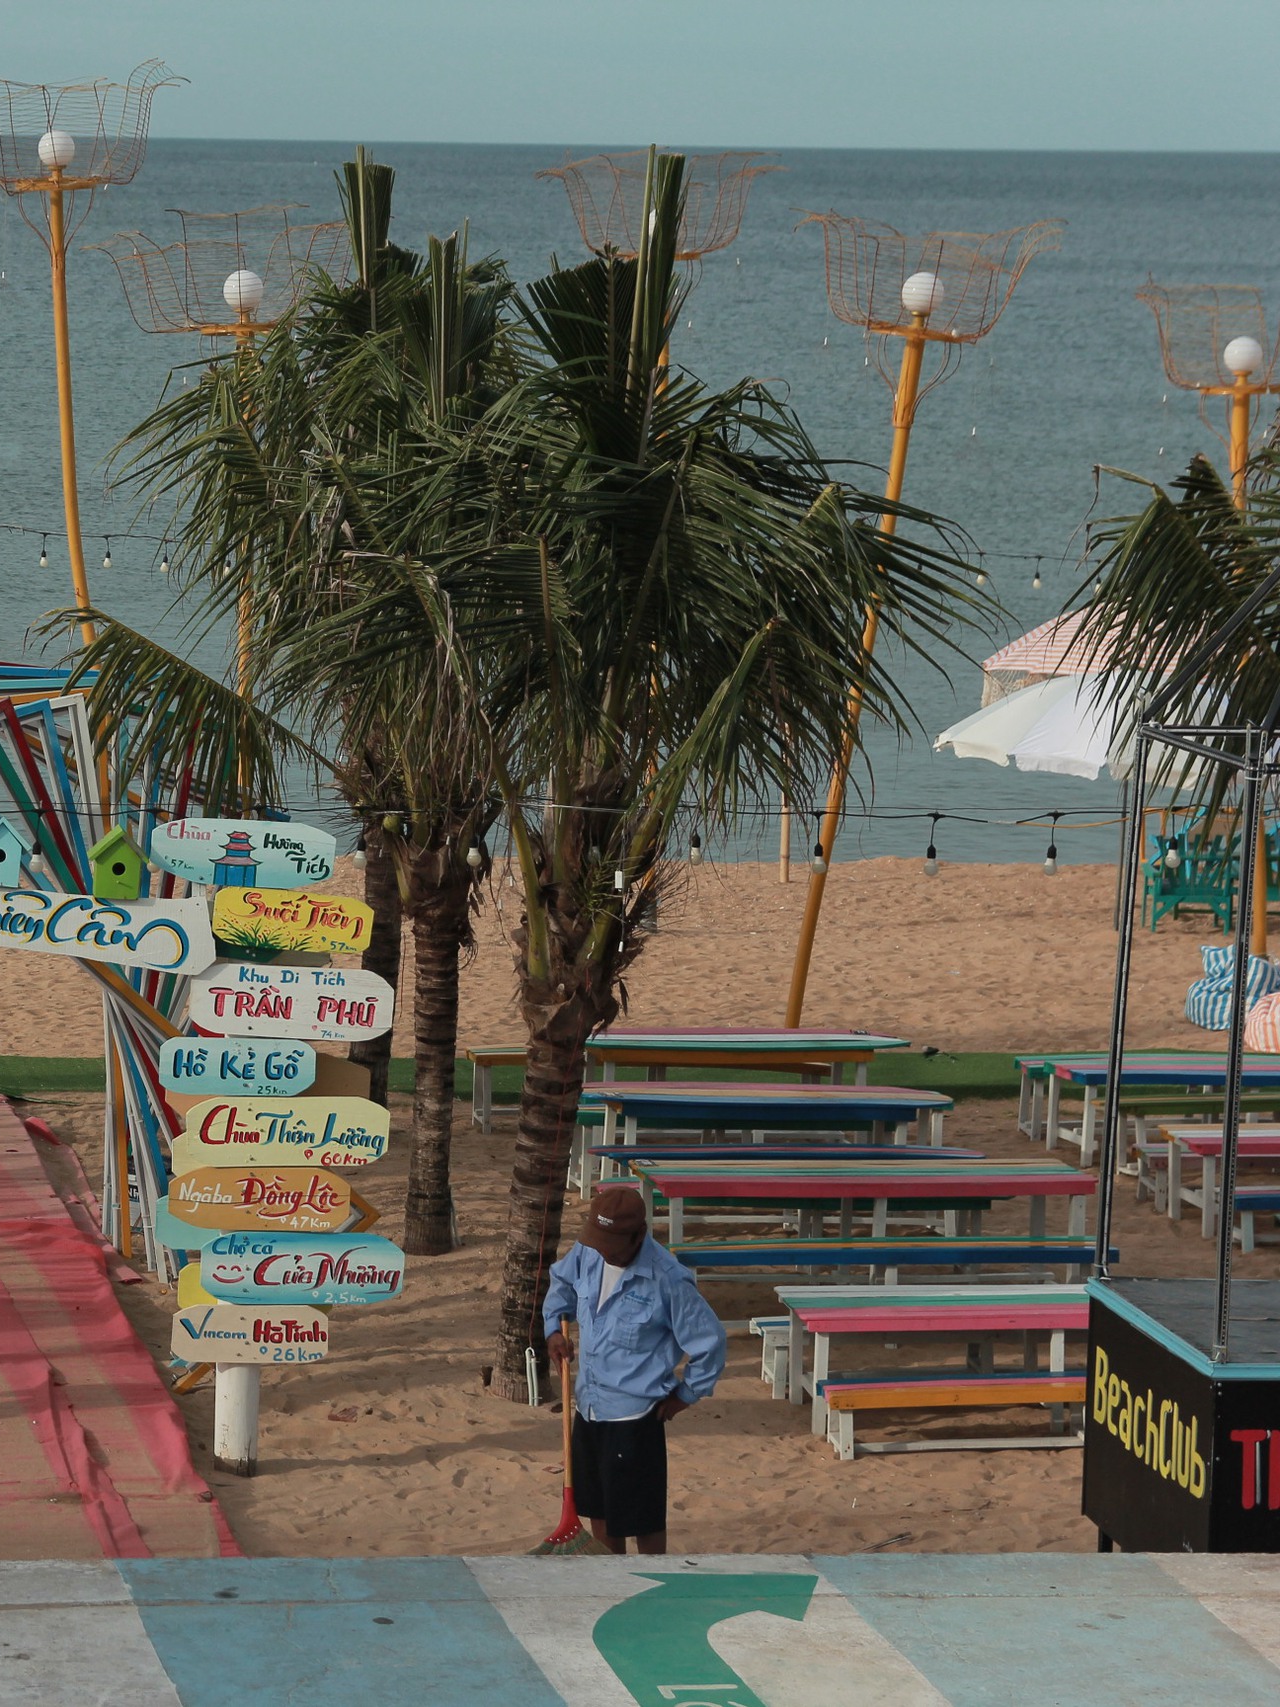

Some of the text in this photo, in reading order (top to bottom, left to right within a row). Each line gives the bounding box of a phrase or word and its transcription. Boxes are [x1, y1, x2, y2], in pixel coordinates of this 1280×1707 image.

[166, 820, 212, 841] Chùa
[290, 855, 330, 881] Tích
[228, 892, 308, 923] Suối
[238, 966, 346, 986] Khu Di Tích
[208, 985, 379, 1028] TRẦN PHÚ
[173, 1048, 208, 1079] Hồ
[264, 1050, 305, 1081] Gỗ
[199, 1104, 261, 1145] Chùa
[234, 1175, 303, 1219] Đồng
[300, 1174, 346, 1214] Lộc
[211, 1233, 277, 1258] Chợ cá
[253, 1246, 401, 1294] Cửa Nhượng
[179, 1308, 247, 1340] Vincom
[1093, 1345, 1207, 1499] BeachClub
